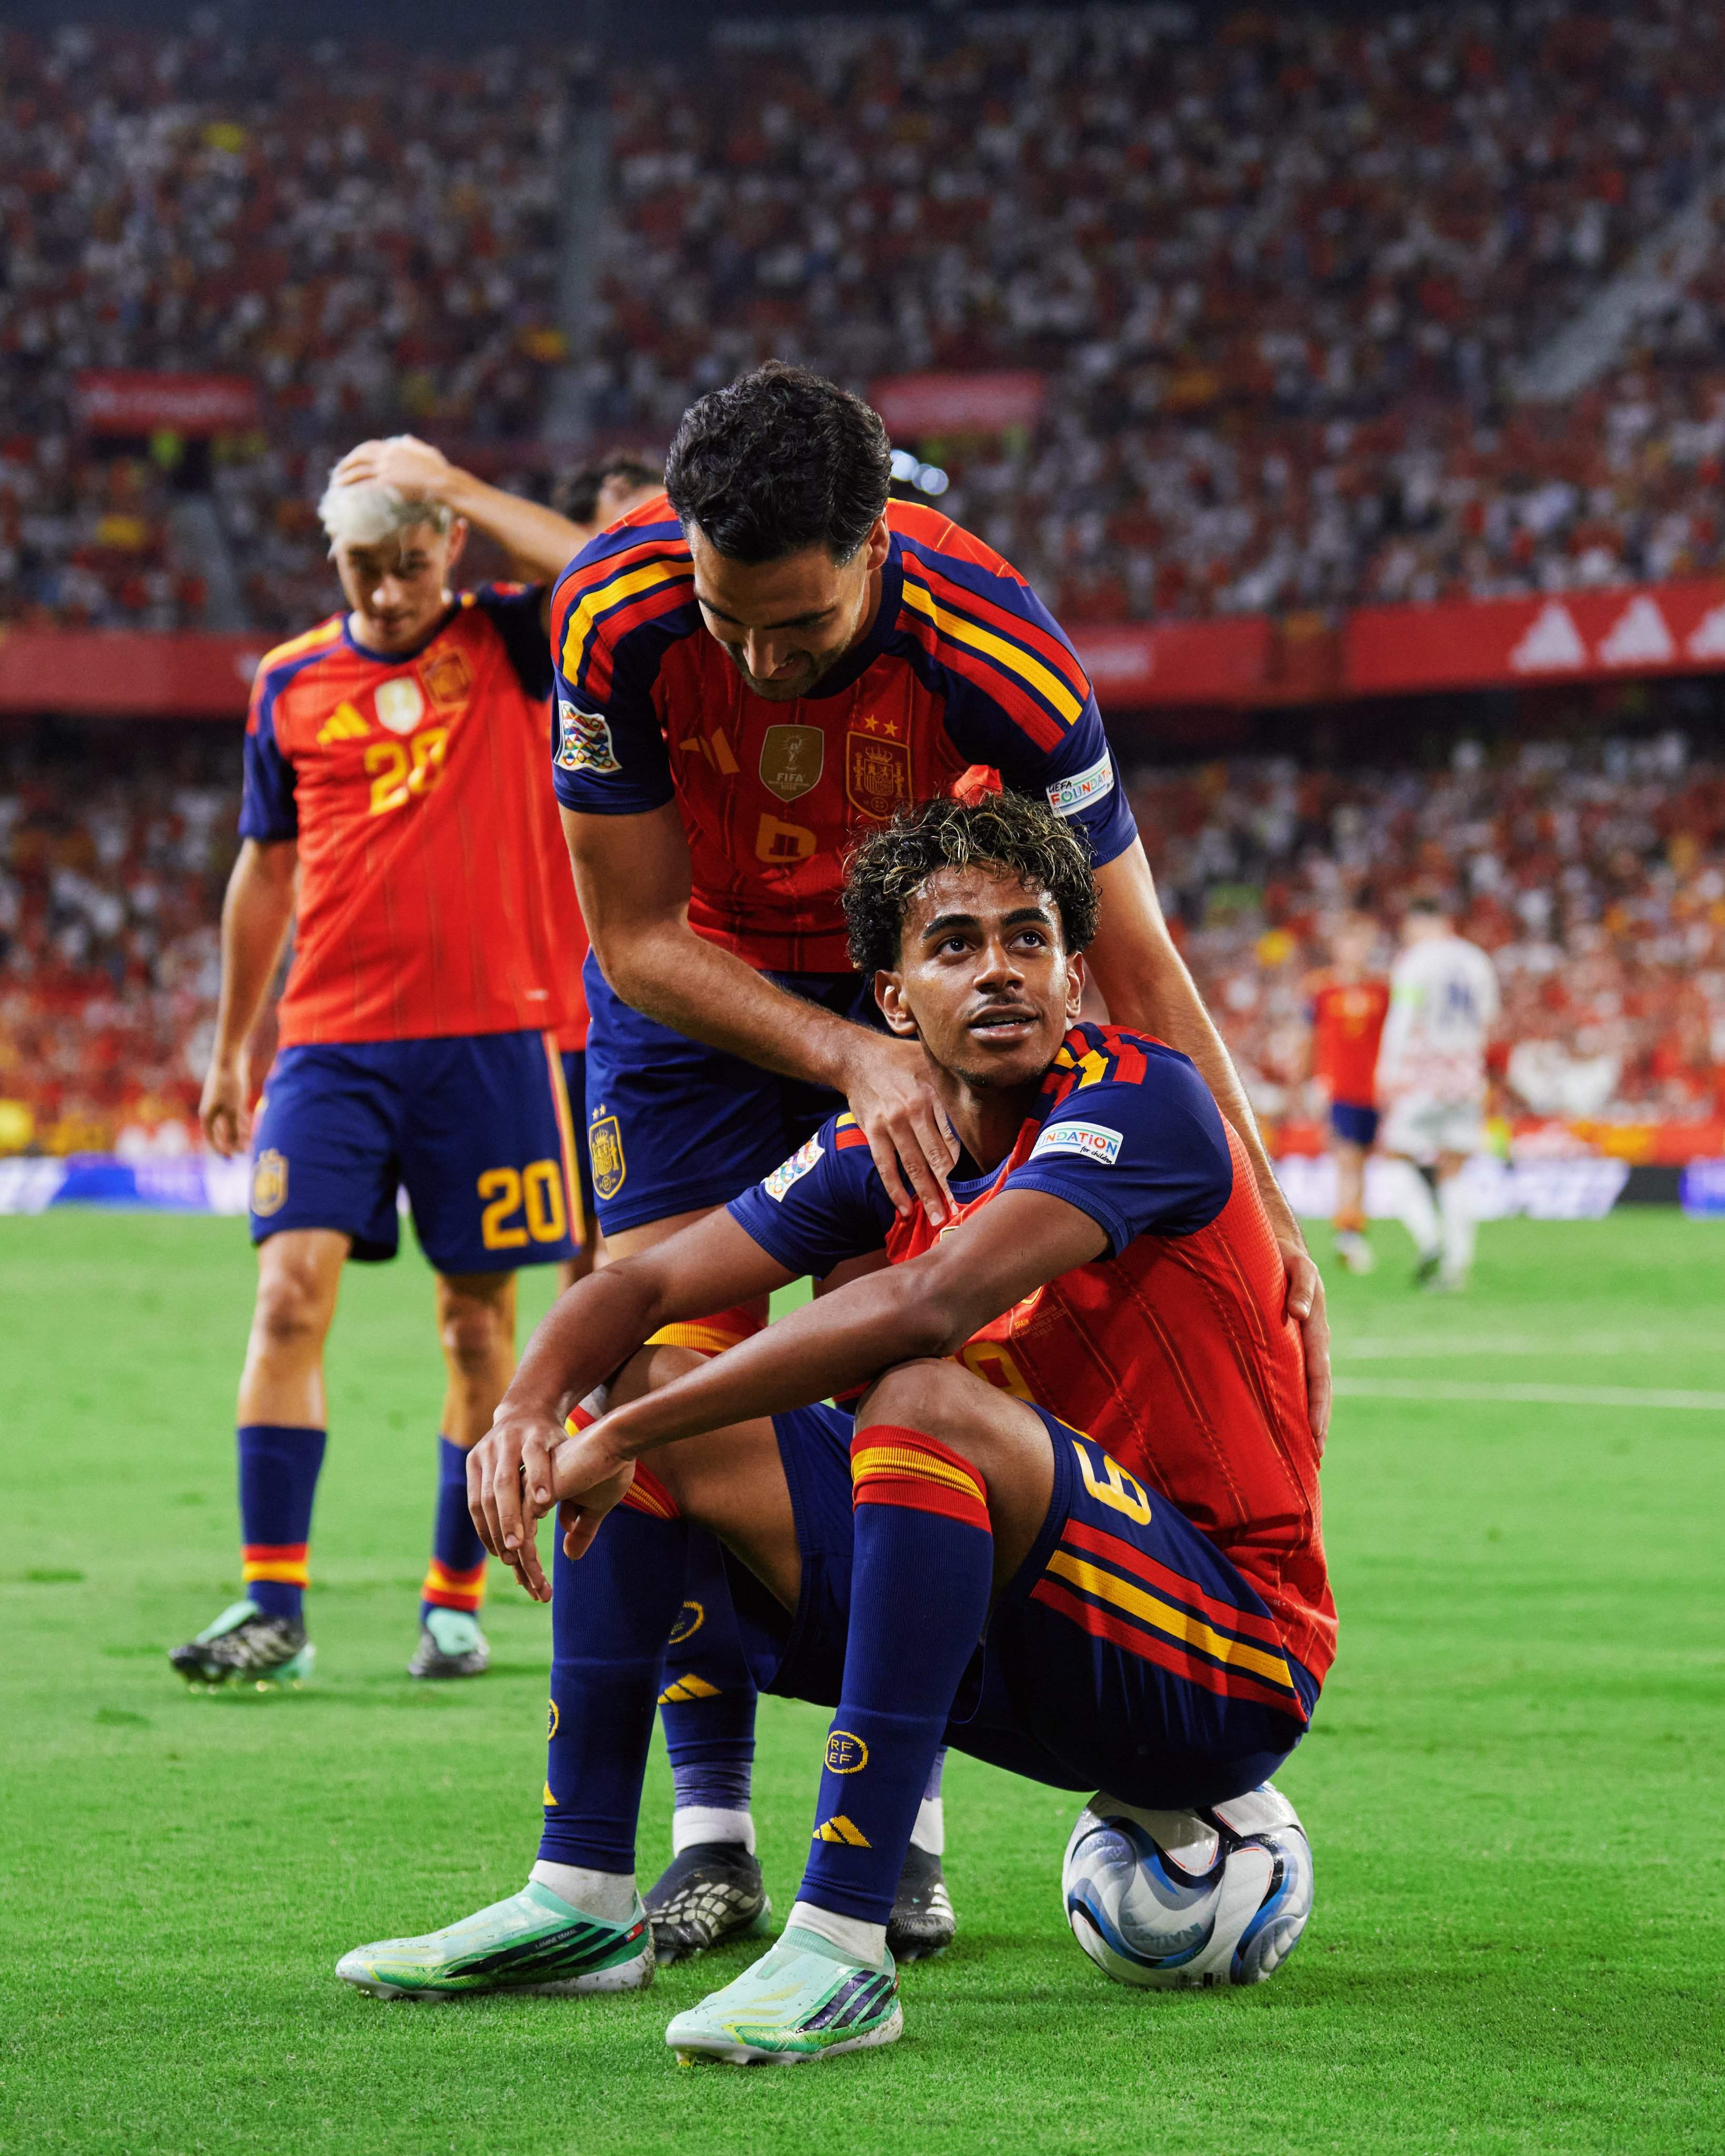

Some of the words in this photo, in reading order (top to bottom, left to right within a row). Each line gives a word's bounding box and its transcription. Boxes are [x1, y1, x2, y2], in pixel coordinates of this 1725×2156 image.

[777, 773, 803, 782] FIFA
[1049, 781, 1072, 793] UEFA
[1045, 1132, 1118, 1156] NDATION
[1091, 1150, 1112, 1164] children
[477, 1160, 566, 1250] 20
[1014, 1318, 1030, 1329] SPAIN
[1052, 1414, 1152, 1525] 9
[831, 1738, 854, 1752] RF
[829, 1752, 852, 1764] EF
[535, 1937, 557, 1950] LAMINE
[557, 1929, 577, 1940] YAMAL
